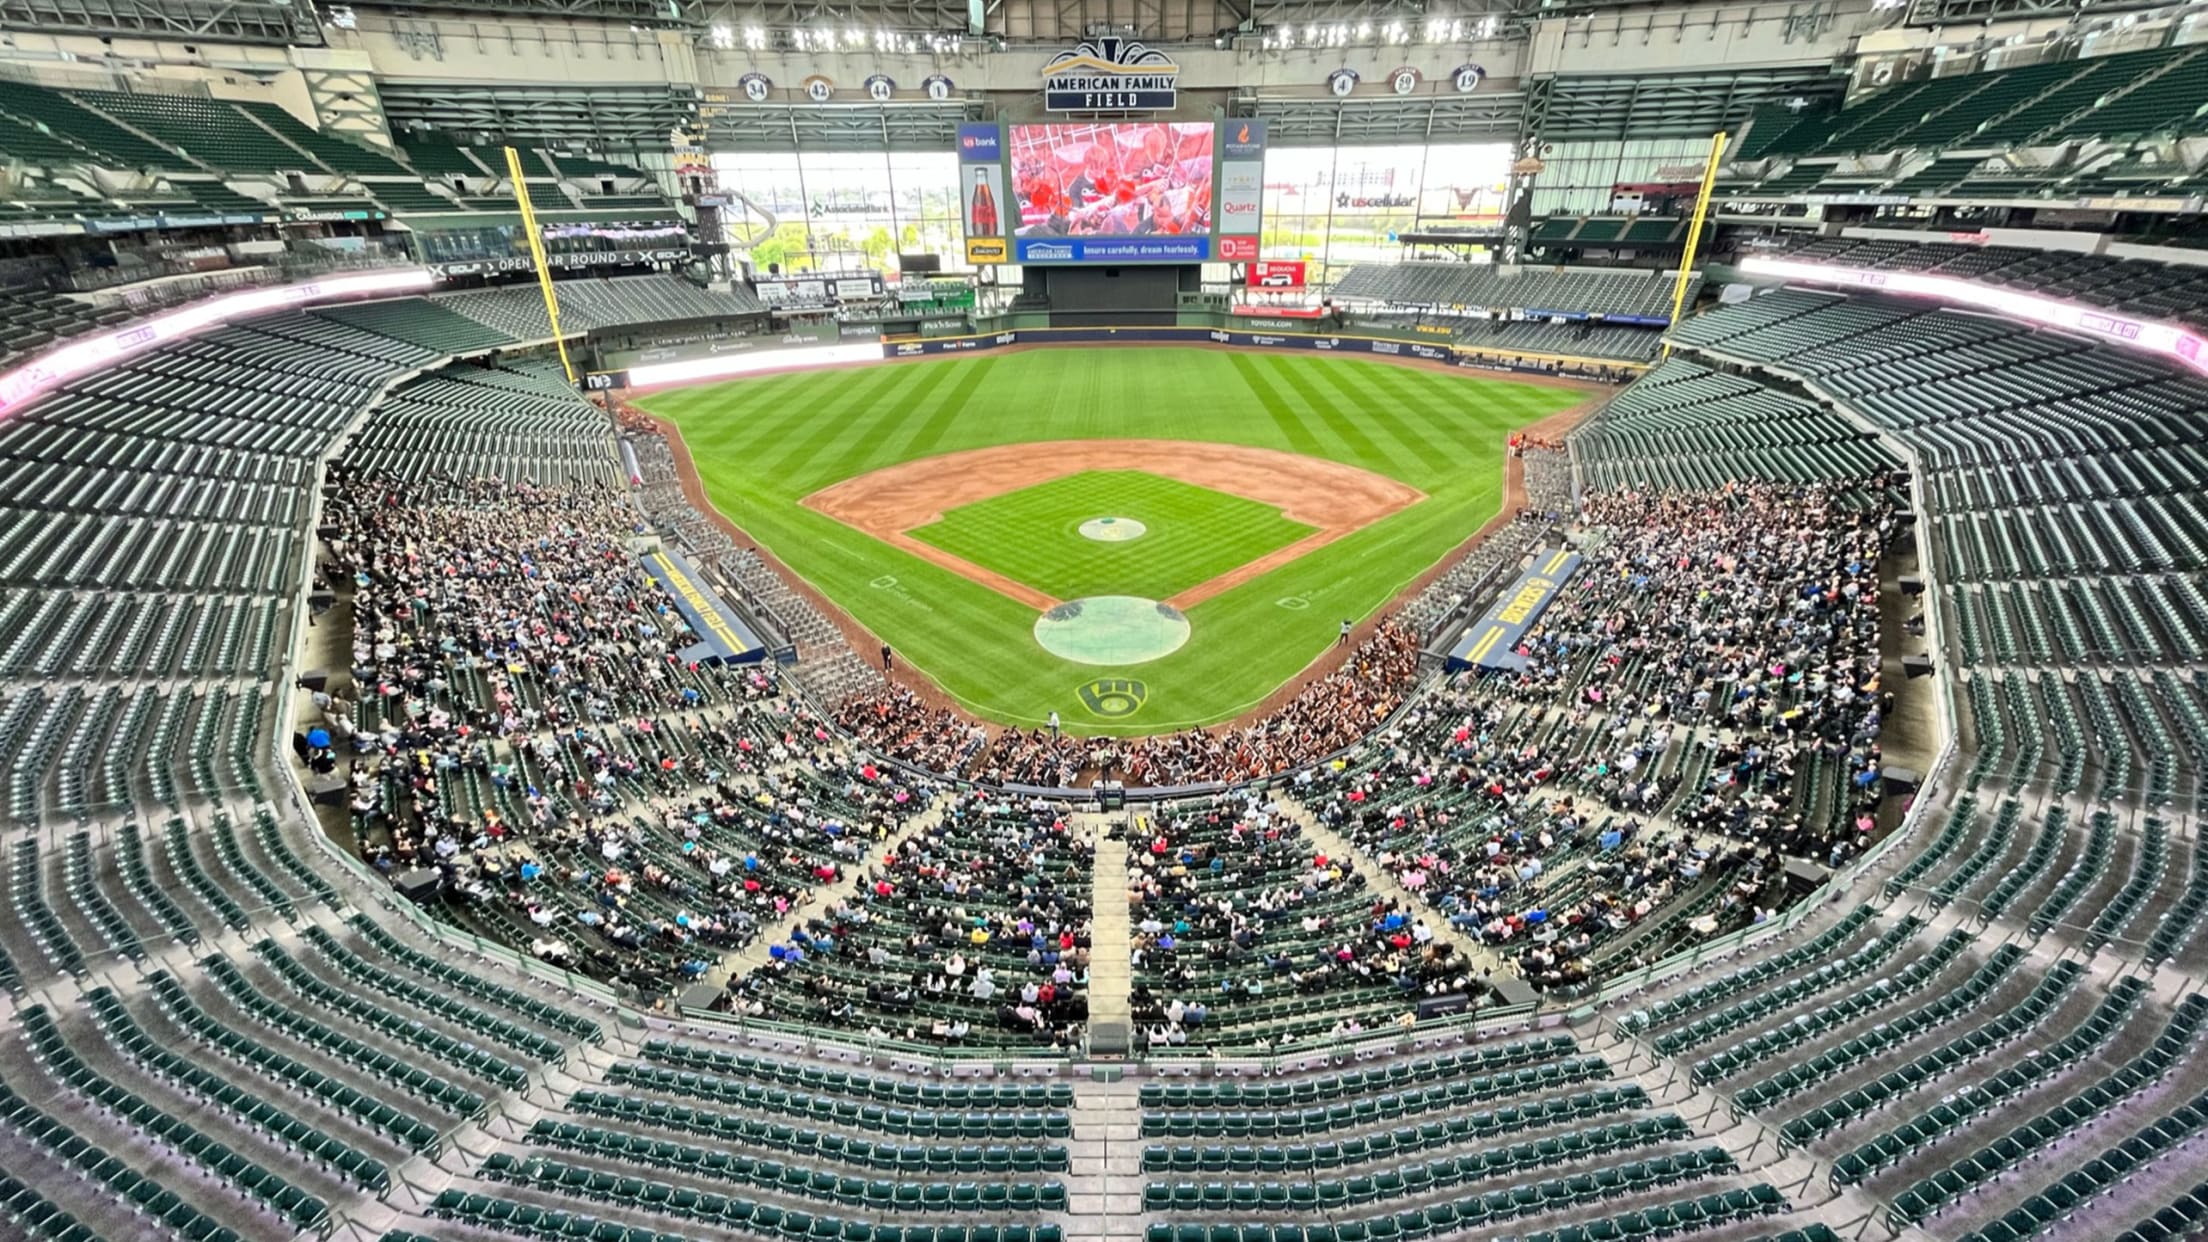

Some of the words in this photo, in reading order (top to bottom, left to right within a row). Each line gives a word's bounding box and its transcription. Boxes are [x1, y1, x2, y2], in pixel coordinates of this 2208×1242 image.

[1048, 78, 1119, 90] AMERICAN
[1125, 77, 1174, 89] FAMILY
[1338, 79, 1346, 91] 4
[1460, 75, 1477, 88] 19
[749, 83, 765, 96] 34
[812, 84, 827, 97] 42
[873, 85, 888, 97] 44
[935, 86, 942, 97] 1
[1086, 93, 1137, 107] FIELD
[975, 137, 997, 147] bank
[1351, 192, 1417, 208] uscellular
[1223, 201, 1257, 215] Quartz
[1140, 245, 1162, 254] dream
[1163, 245, 1199, 256] fearlessly.
[448, 263, 481, 275] GOLF
[499, 258, 531, 271] OPEN
[570, 252, 617, 265] ROUND
[656, 250, 688, 260] GOLF
[1250, 319, 1293, 329] TOYOTA.COM
